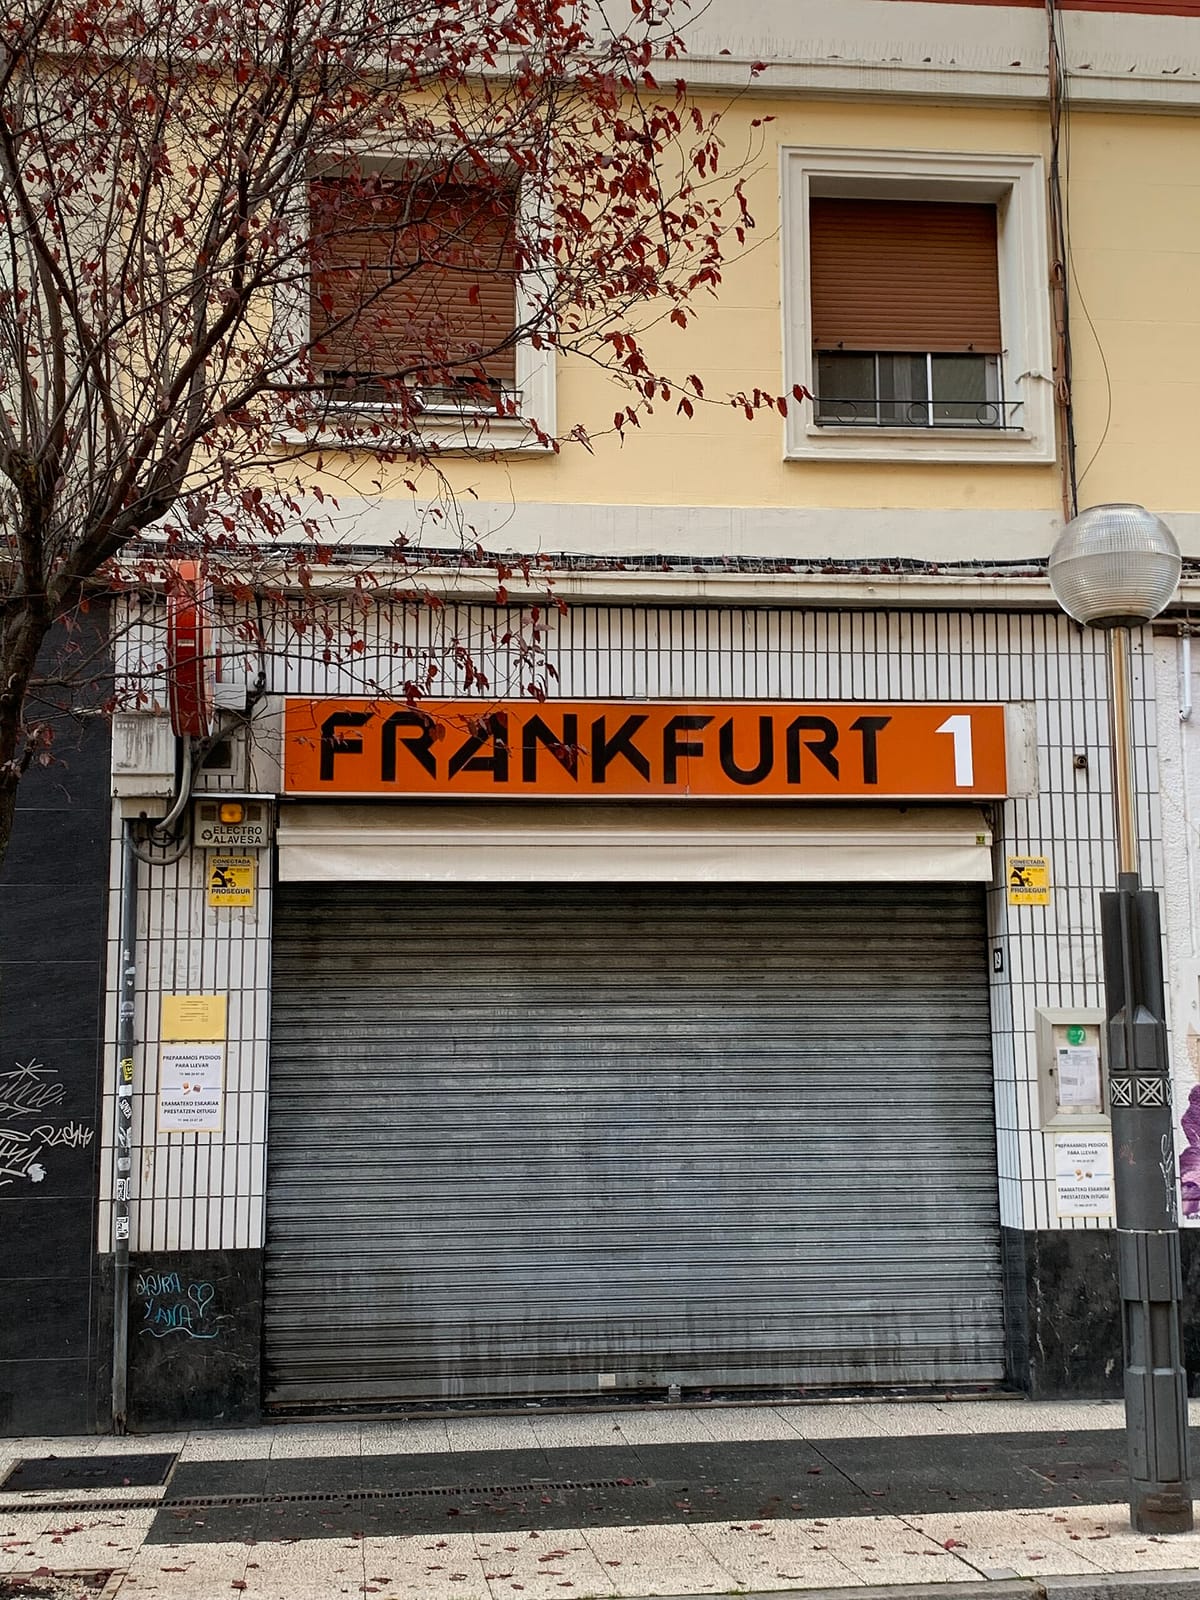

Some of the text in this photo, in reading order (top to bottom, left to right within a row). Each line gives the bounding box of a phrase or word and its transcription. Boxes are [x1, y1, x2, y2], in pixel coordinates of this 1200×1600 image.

[319, 711, 975, 787] FRANKFURT 1
[213, 826, 262, 835] ELECTRO
[213, 836, 261, 844] ALAVESA
